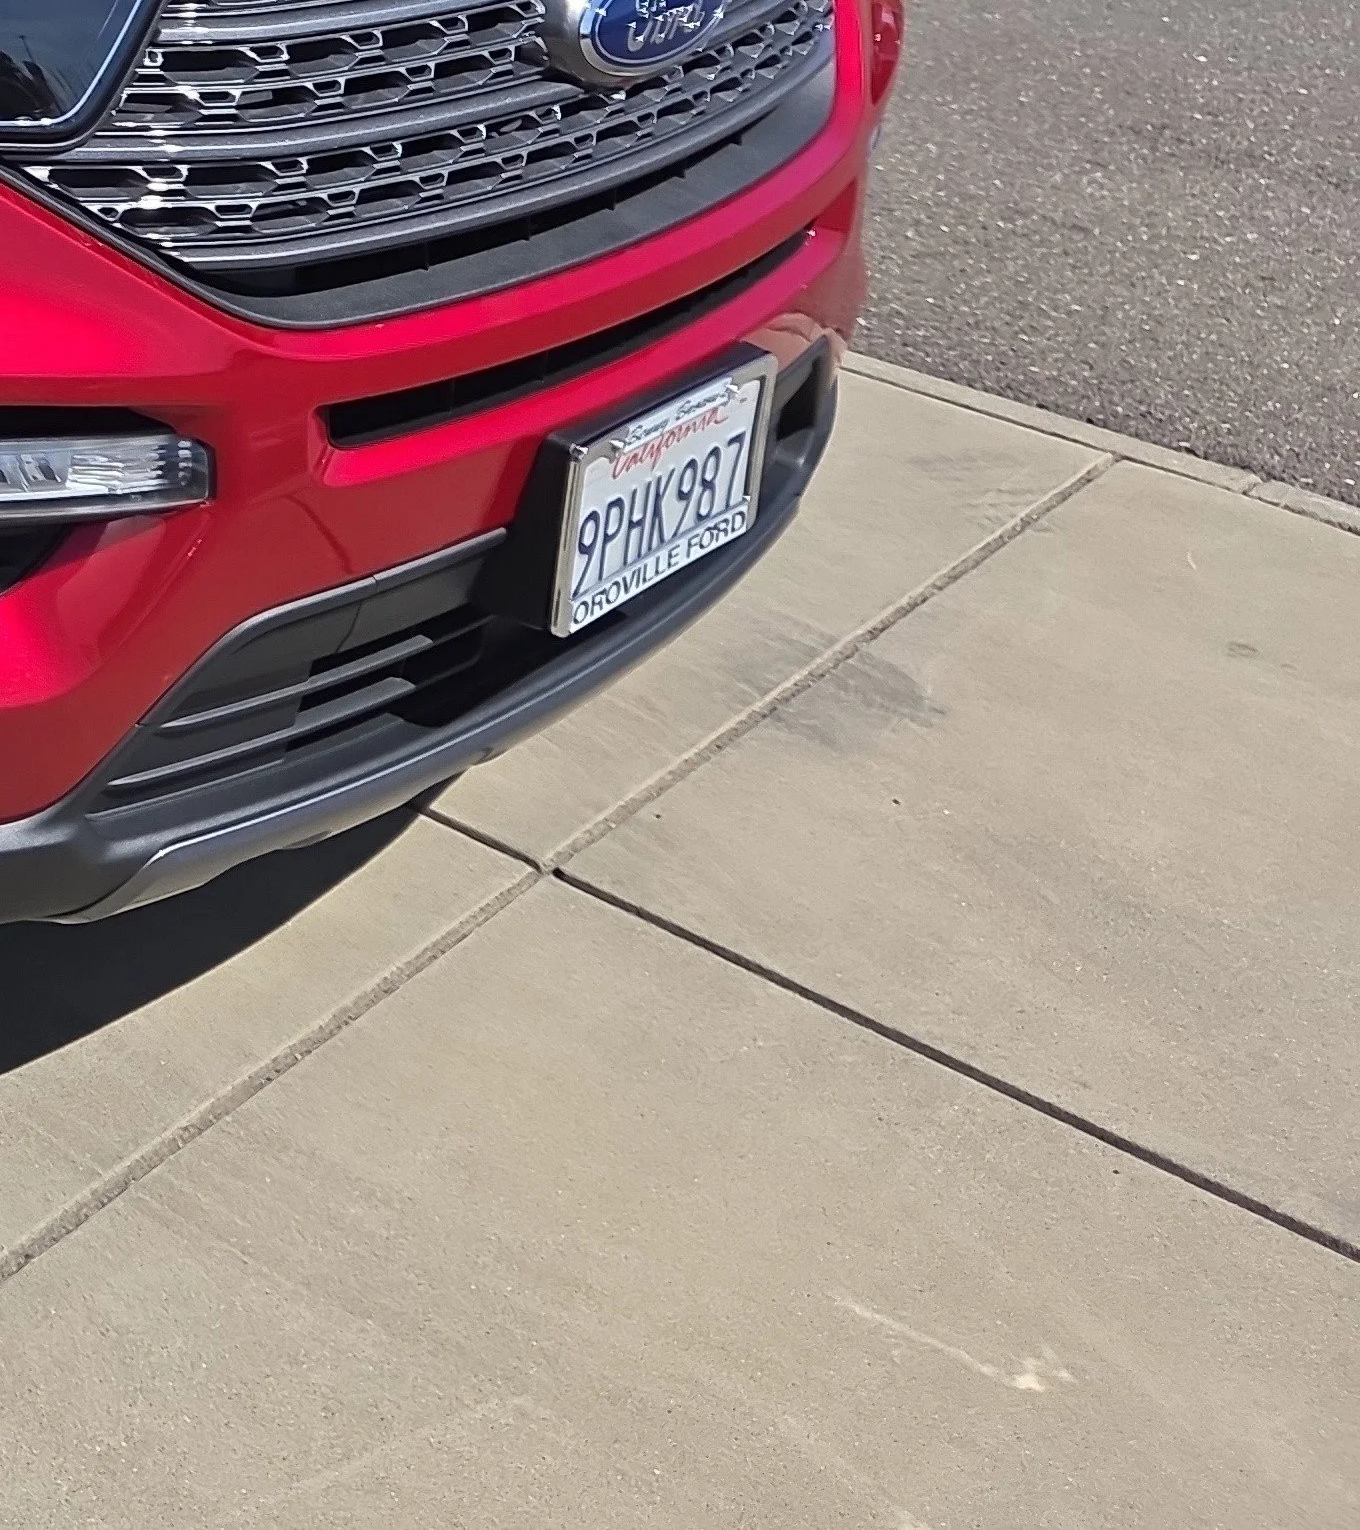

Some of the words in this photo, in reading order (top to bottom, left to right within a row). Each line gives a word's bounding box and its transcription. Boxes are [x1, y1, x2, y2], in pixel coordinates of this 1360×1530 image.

[611, 404, 729, 480] California
[571, 429, 747, 599] 9PHK987
[573, 546, 681, 625] OROVILLE
[685, 509, 747, 559] FORD
